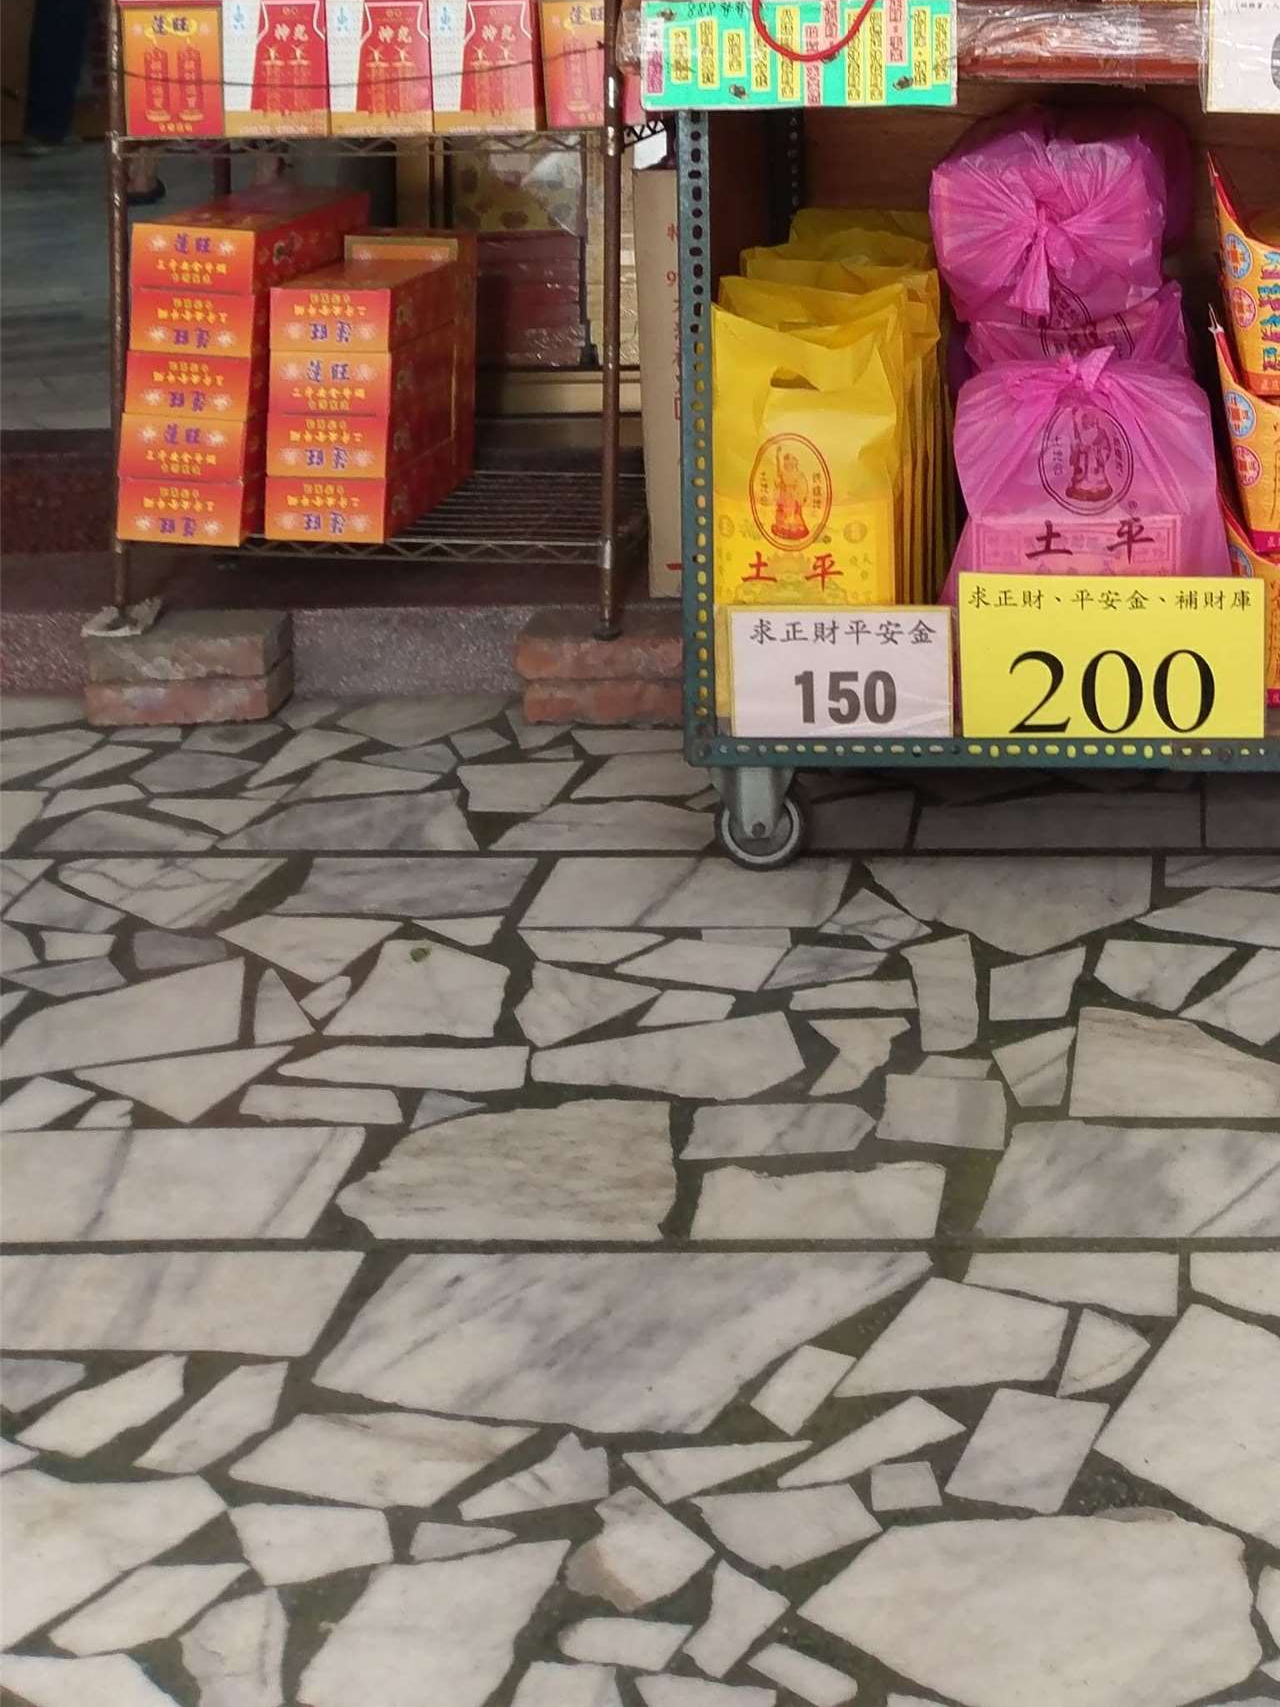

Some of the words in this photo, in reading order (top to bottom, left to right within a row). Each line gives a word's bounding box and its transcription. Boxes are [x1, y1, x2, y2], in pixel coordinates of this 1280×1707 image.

[1025, 520, 1074, 560] 土
[1107, 516, 1155, 564] 平
[741, 550, 778, 583] 土
[804, 552, 844, 593] 平
[968, 588, 1253, 611] 求正財、平安金、補財庫
[749, 619, 938, 646] 求正財平安金
[794, 669, 898, 725] 150
[1008, 648, 1217, 735] 200
